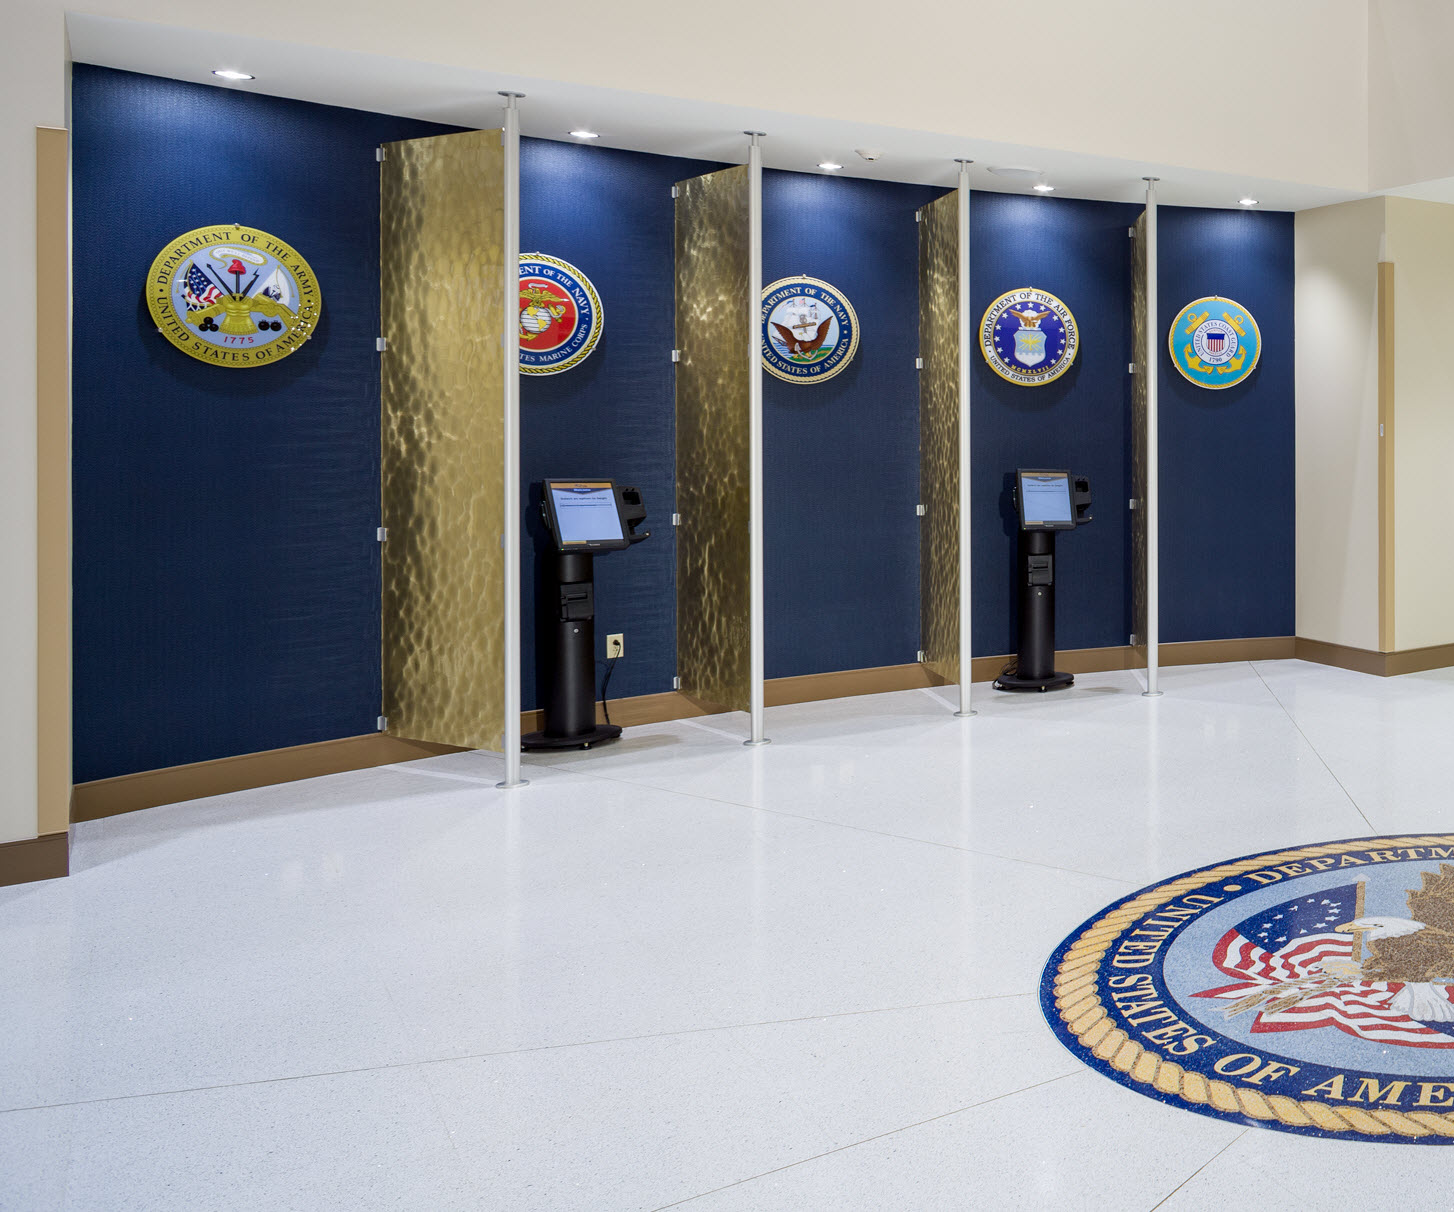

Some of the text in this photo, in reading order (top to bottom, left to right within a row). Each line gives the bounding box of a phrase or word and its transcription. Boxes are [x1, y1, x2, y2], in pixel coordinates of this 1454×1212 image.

[156, 231, 231, 285] DEPARTMENT
[240, 233, 259, 244] OF
[266, 241, 291, 262] THE
[290, 264, 314, 302] ARMY
[543, 268, 555, 276] OF
[556, 273, 573, 288] THE
[571, 287, 590, 315] NAVY
[804, 287, 817, 296] OF
[821, 292, 838, 307] THE
[834, 305, 849, 326] NAVY
[156, 297, 314, 361] UNITED STATES OF AMERICA
[223, 336, 254, 344] 1775
[984, 294, 1019, 347] DEPARTMENT
[1035, 293, 1054, 306] THE
[1053, 305, 1068, 318] AIR
[1065, 319, 1076, 350] FORCE
[1200, 322, 1217, 334] STATES
[1218, 322, 1235, 337] COAST
[540, 347, 573, 362] MARINE
[571, 323, 588, 347] CORPS
[777, 360, 808, 375] STATES
[810, 365, 821, 374] OF
[824, 338, 849, 369] AMERICA
[990, 355, 1010, 376] UNITED
[1010, 373, 1036, 382] STATES
[1047, 357, 1071, 379] AMERICA
[1112, 894, 1225, 968] UNITED
[1108, 973, 1218, 1056] STATES
[1213, 1053, 1301, 1085] OF
